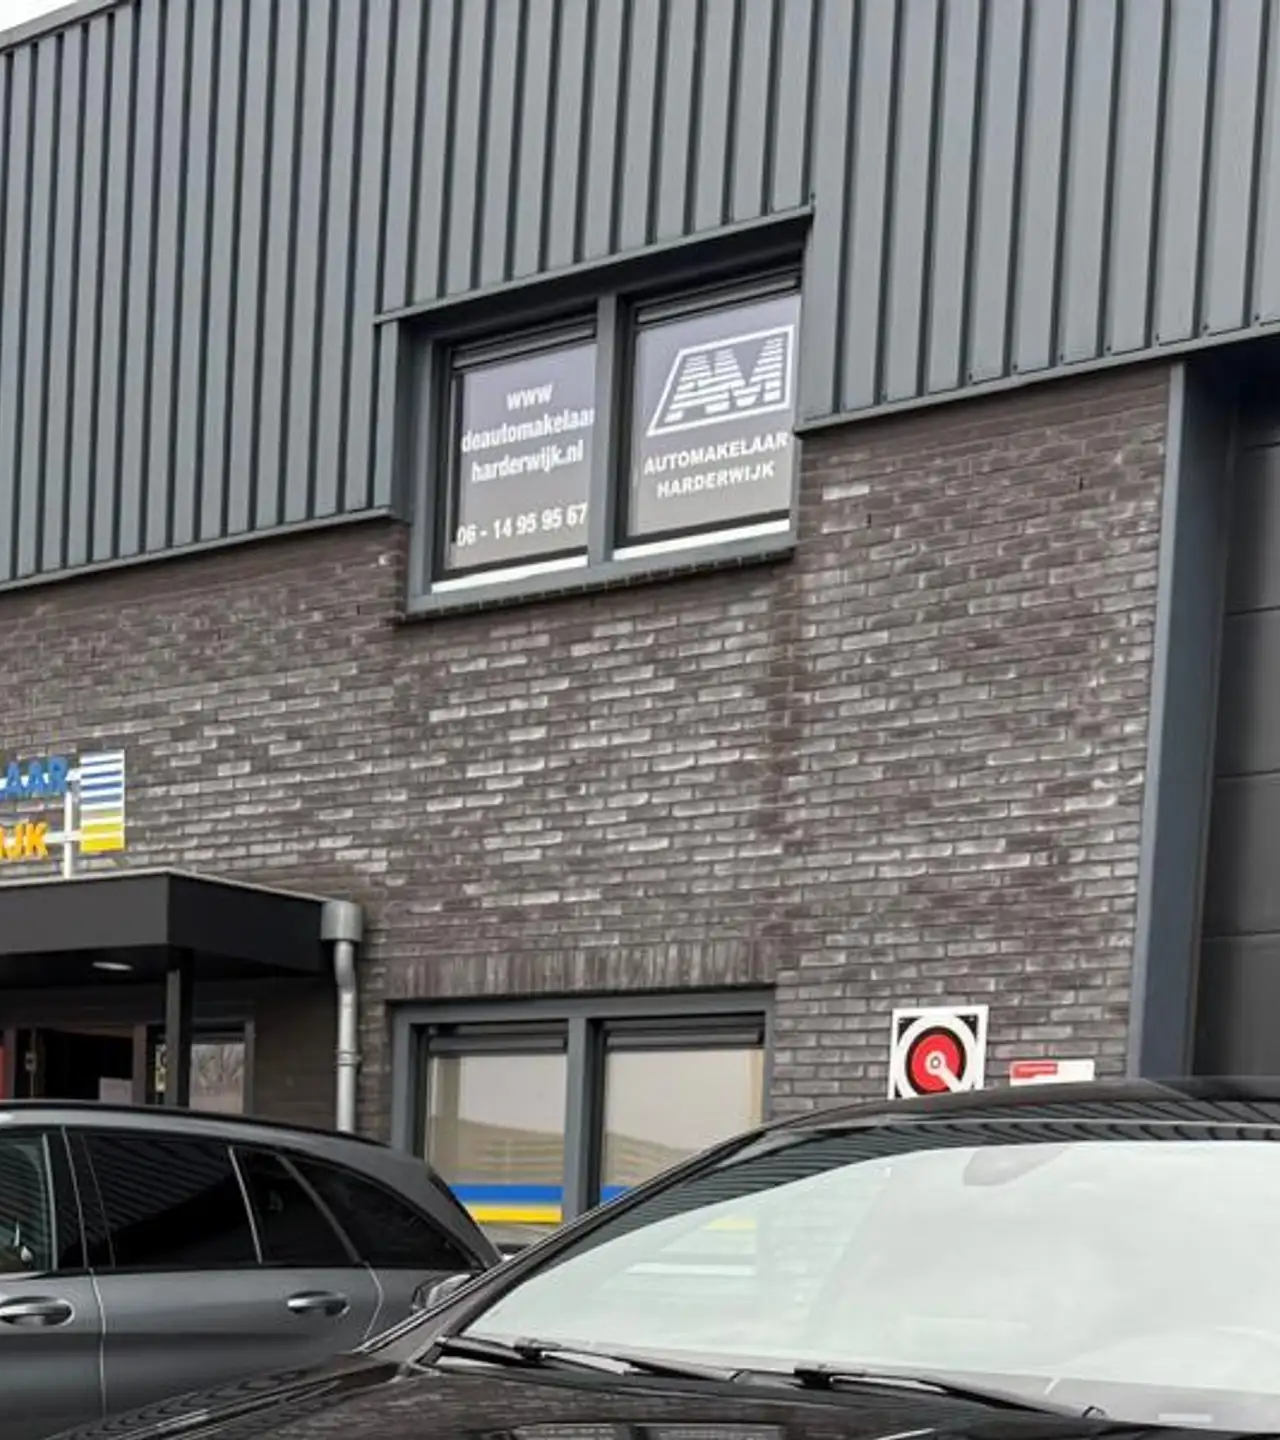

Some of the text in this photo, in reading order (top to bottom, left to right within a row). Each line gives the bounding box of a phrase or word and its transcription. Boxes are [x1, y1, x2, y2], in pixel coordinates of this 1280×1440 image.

[506, 383, 553, 411] www
[471, 439, 585, 485] harderwijk.nl
[643, 430, 790, 476] AUTOMAKELAAR
[655, 460, 776, 499] HARDERWIJK
[456, 523, 477, 547] 06
[493, 517, 513, 540] 14
[516, 512, 537, 536] 95
[541, 507, 564, 532] 95
